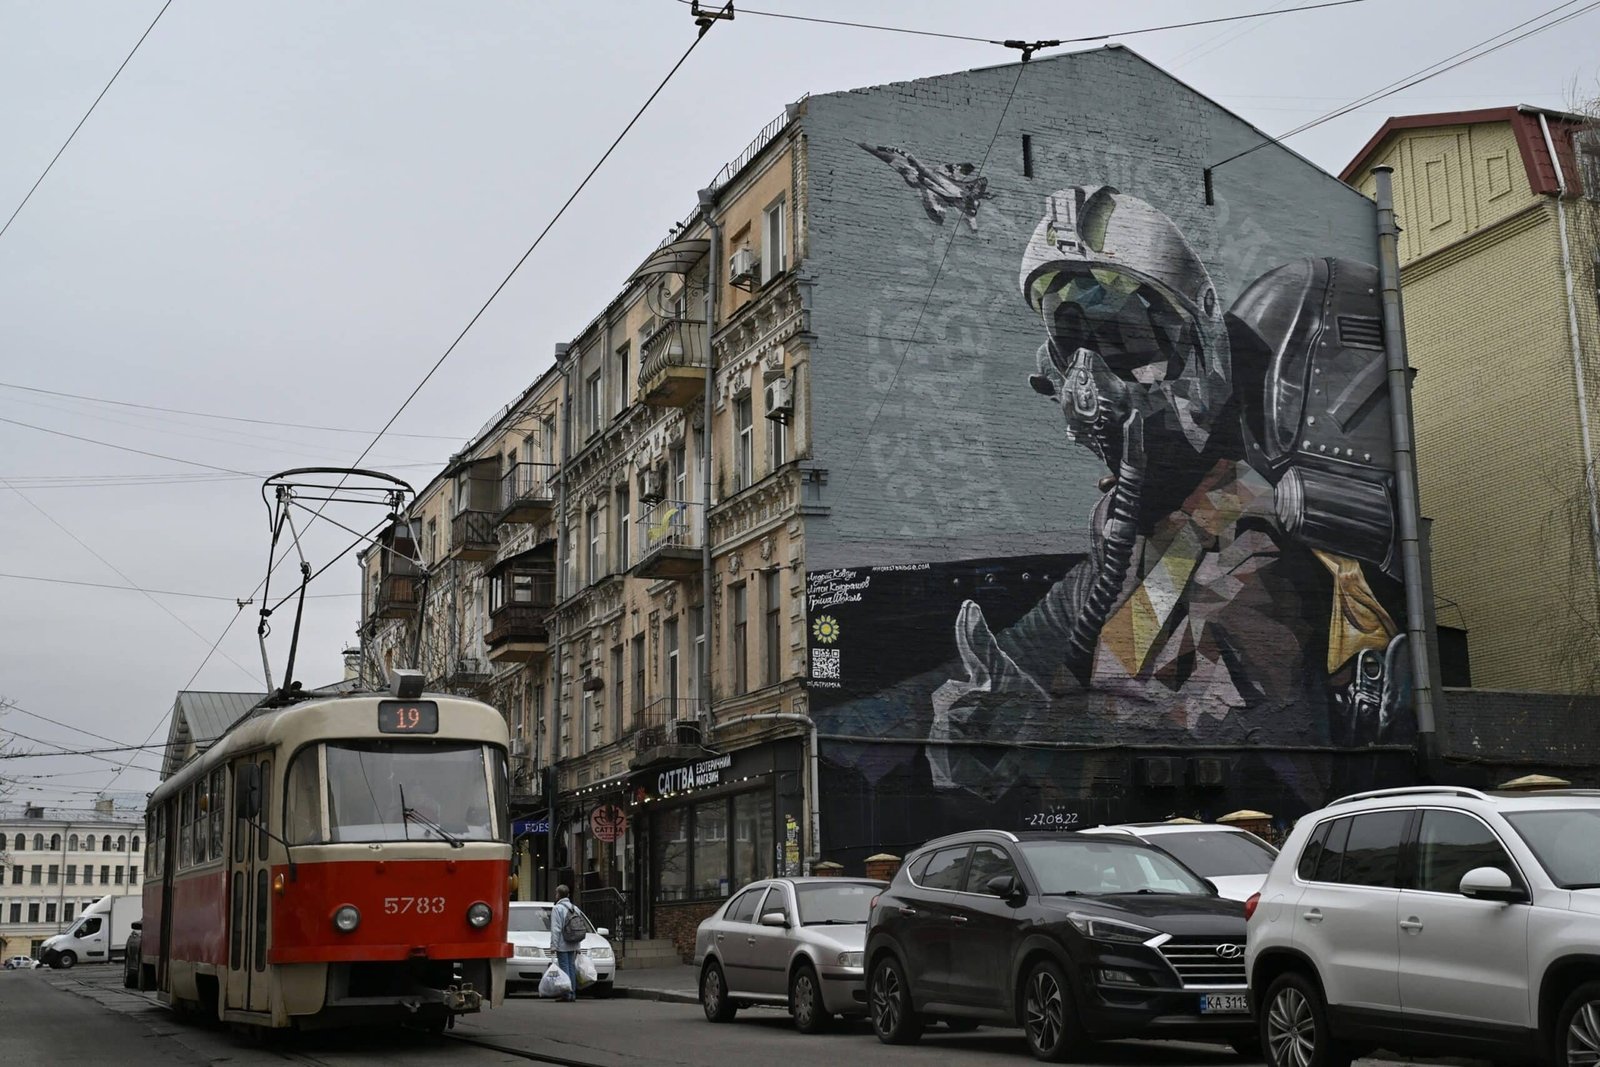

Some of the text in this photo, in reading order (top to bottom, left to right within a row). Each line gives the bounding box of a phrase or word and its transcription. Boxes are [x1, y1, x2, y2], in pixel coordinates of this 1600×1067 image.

[396, 708, 420, 729] 19
[657, 765, 695, 795] САТТВА
[384, 897, 446, 914] 5783
